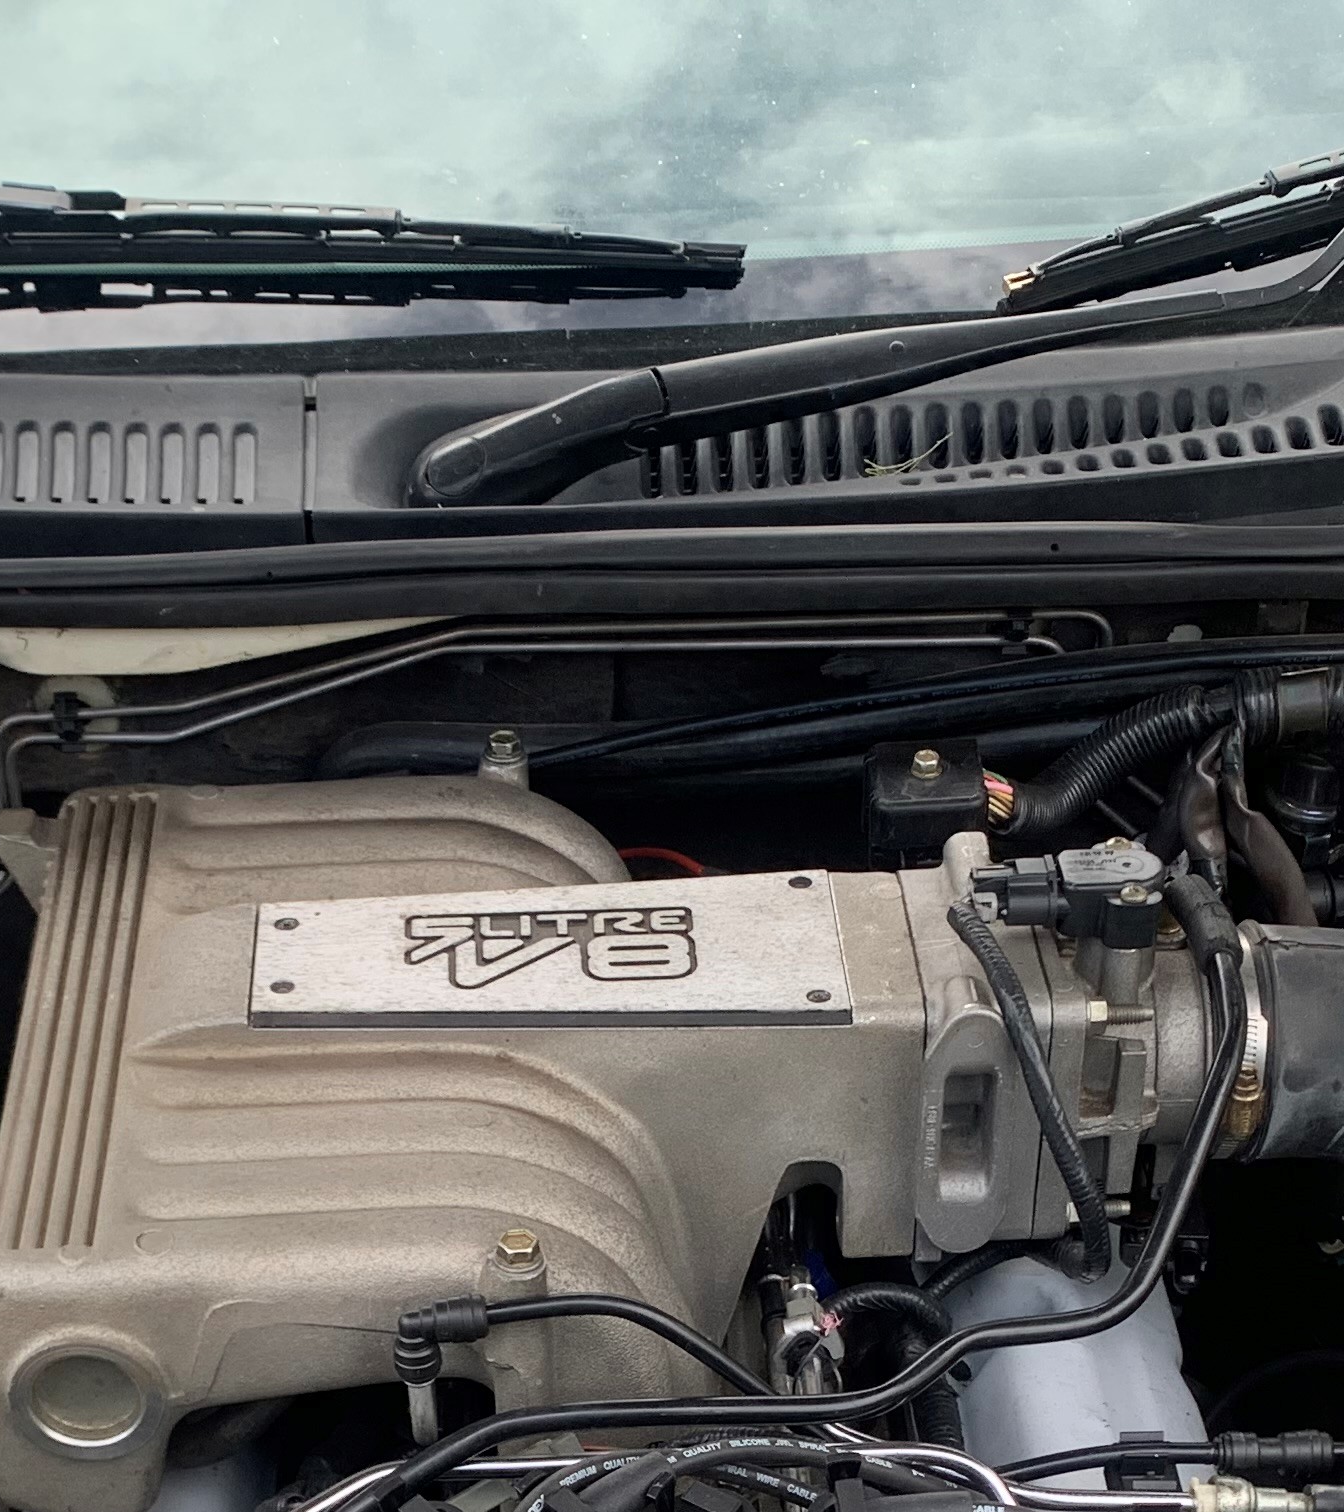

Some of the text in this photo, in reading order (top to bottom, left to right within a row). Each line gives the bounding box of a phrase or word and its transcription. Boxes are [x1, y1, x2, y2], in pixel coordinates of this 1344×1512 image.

[451, 932, 696, 988] V8
[682, 1441, 721, 1458] QUALITY
[728, 1438, 771, 1448] SILICONE
[865, 1455, 892, 1469] CABLE
[559, 1465, 597, 1488] PREMIUM
[756, 1471, 780, 1488] WIRE
[786, 1483, 818, 1502] CABLE
